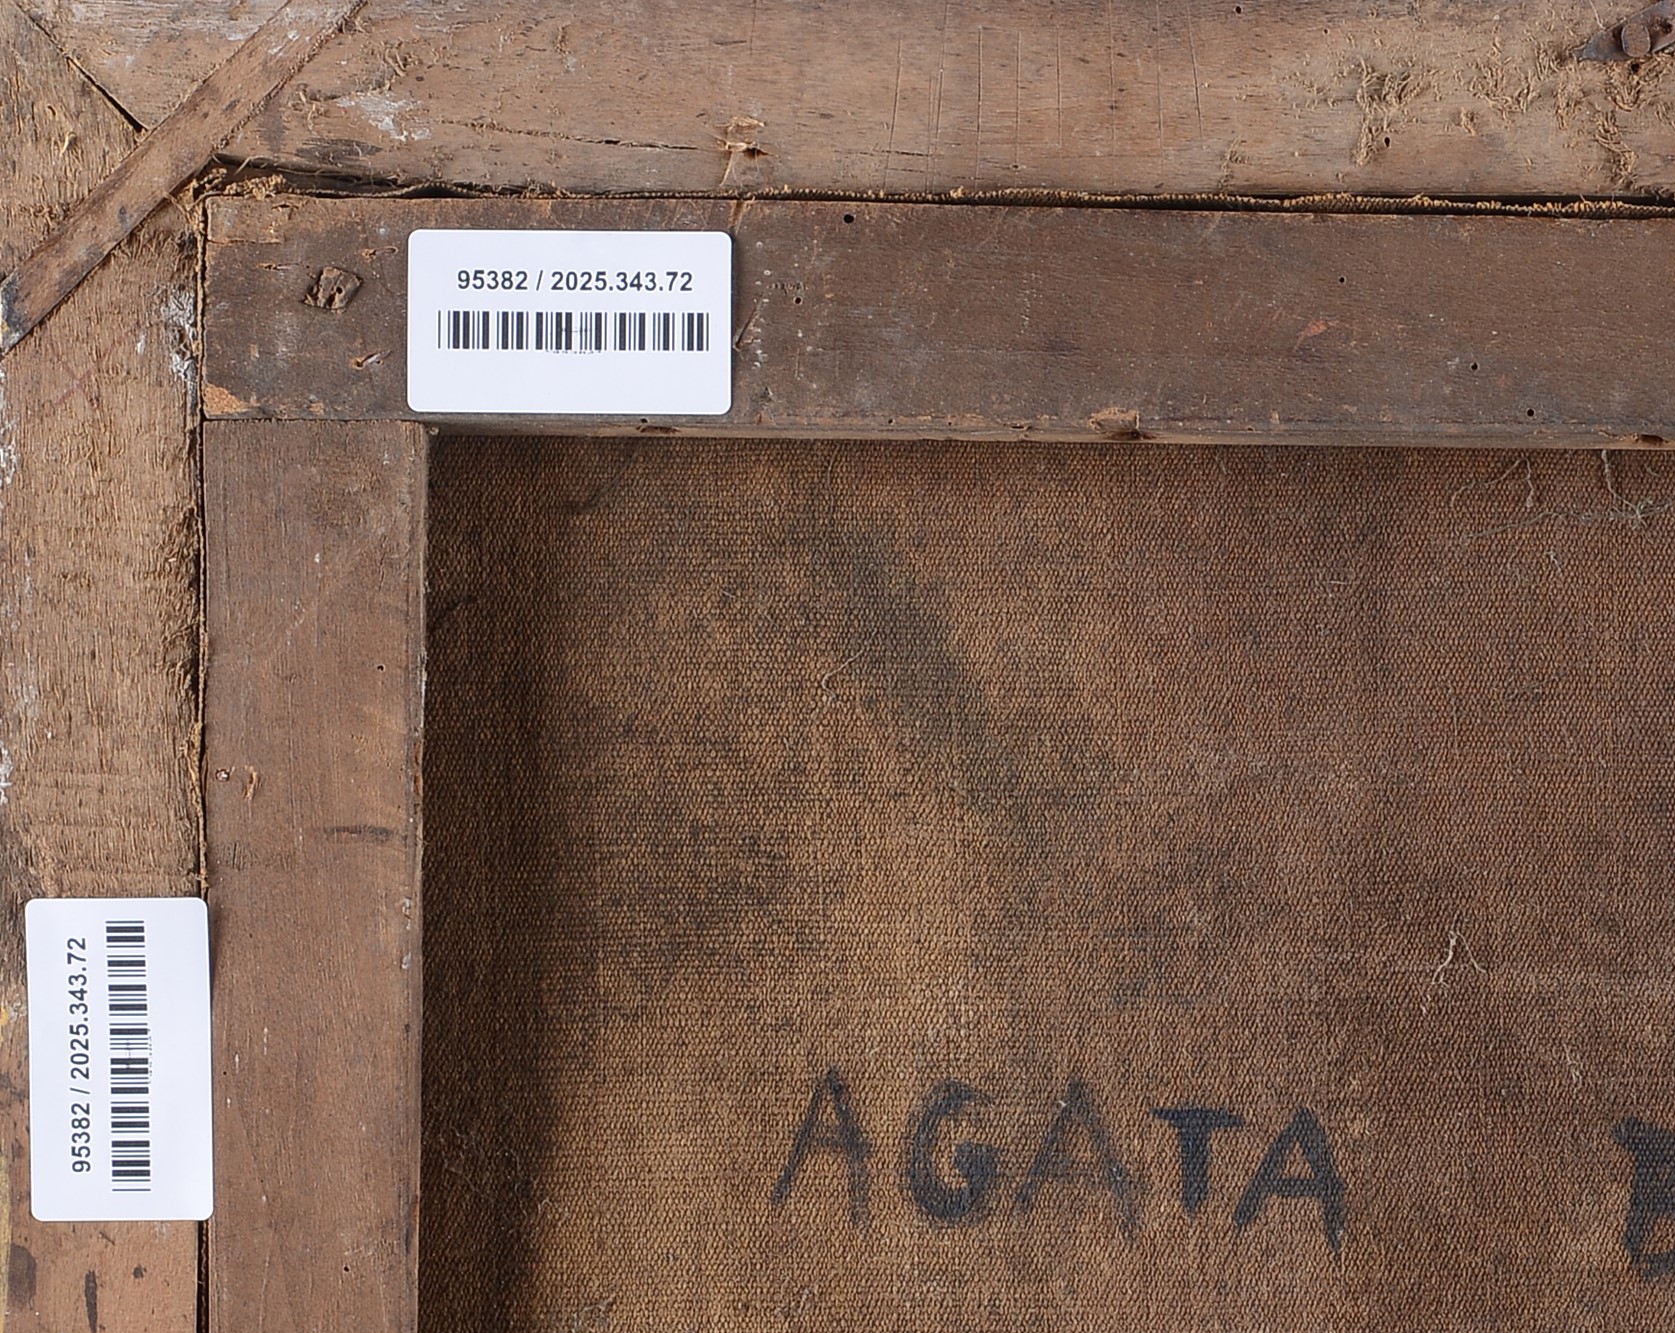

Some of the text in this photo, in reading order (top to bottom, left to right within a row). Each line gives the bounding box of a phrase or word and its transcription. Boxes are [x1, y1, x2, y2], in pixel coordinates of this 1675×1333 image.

[457, 270, 693, 292] 95382 / 2025.343.72
[67, 937, 91, 1173] 95382 / 2025.343.72
[771, 1069, 1347, 1252] AGATA
